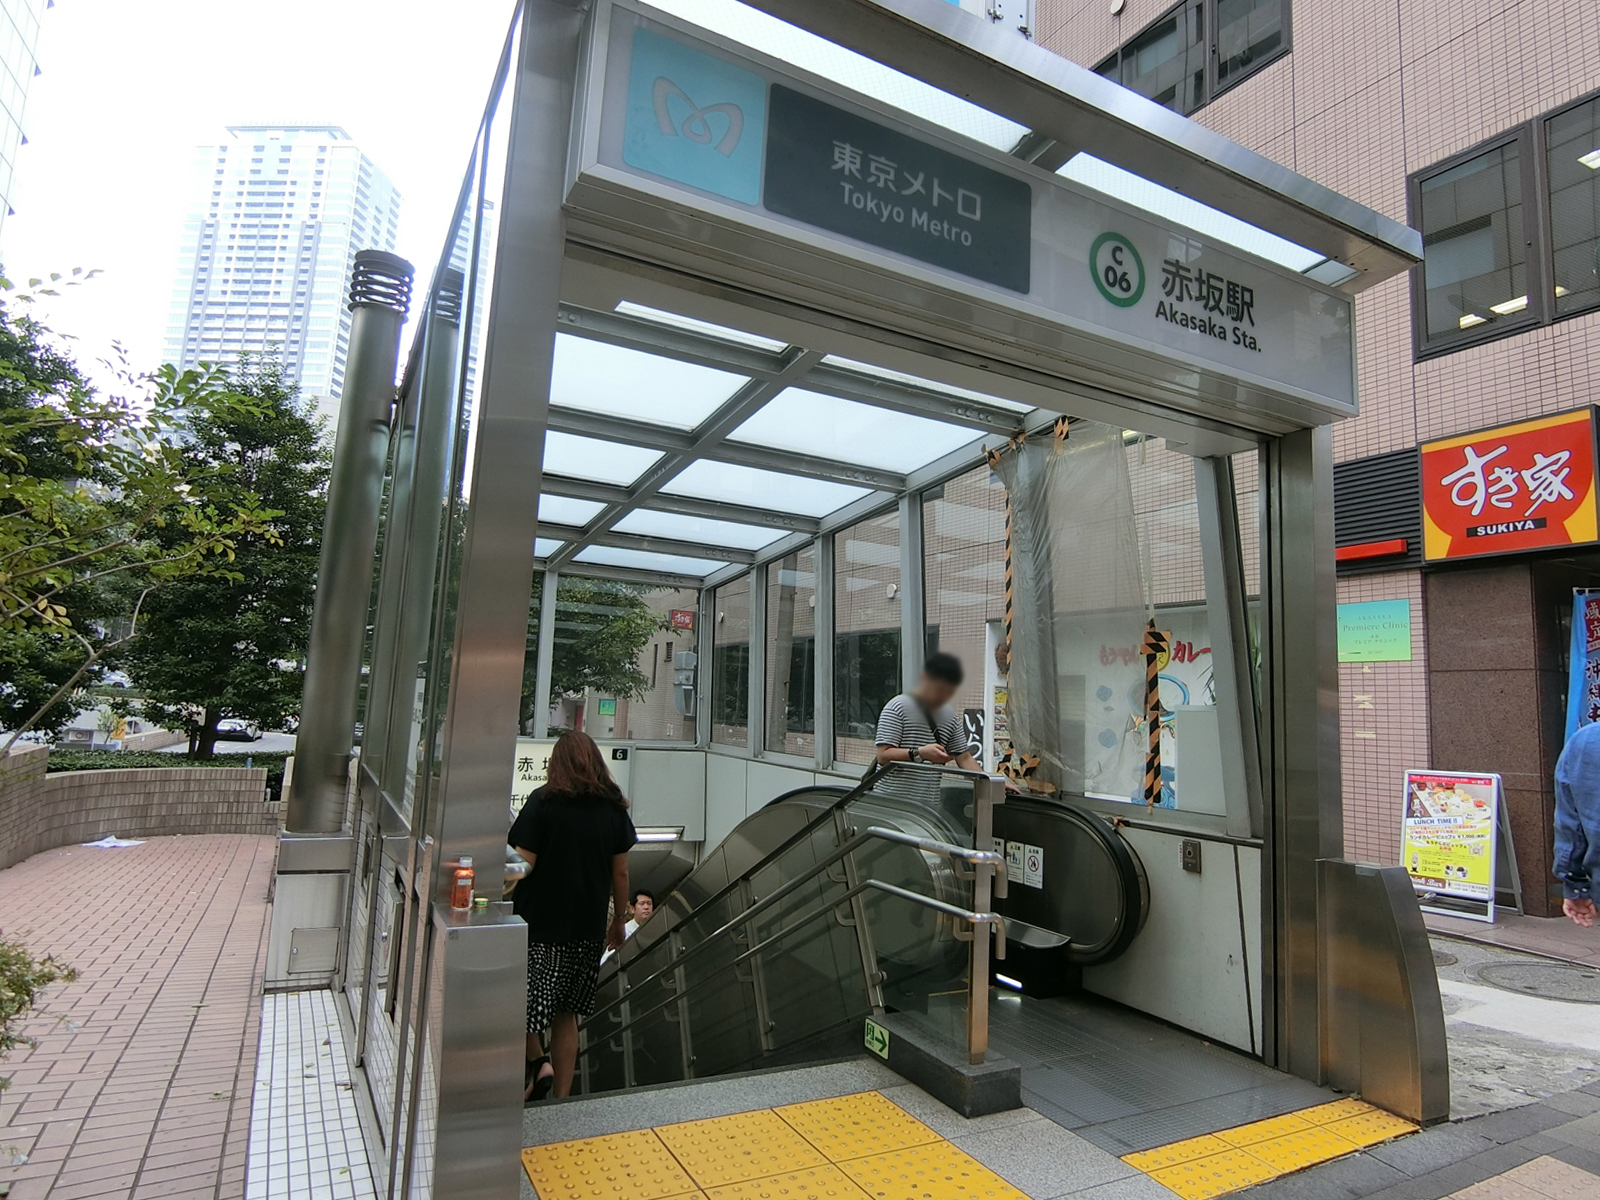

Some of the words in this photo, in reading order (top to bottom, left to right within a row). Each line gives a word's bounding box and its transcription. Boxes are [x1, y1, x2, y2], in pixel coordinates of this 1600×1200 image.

[830, 139, 982, 222] 東京メトロ
[840, 181, 905, 224] Tokyo
[911, 206, 973, 247] Metro
[1111, 245, 1124, 267] C
[1104, 265, 1132, 293] 06
[1161, 258, 1256, 328] 赤坂駅
[1155, 299, 1228, 342] Akasaka
[1232, 326, 1263, 353] Sta.
[1440, 444, 1575, 518] すき家
[1476, 519, 1536, 537] SUKIYA
[1170, 640, 1212, 664] カレー
[616, 749, 624, 760] 6
[521, 773, 548, 782] Akasa
